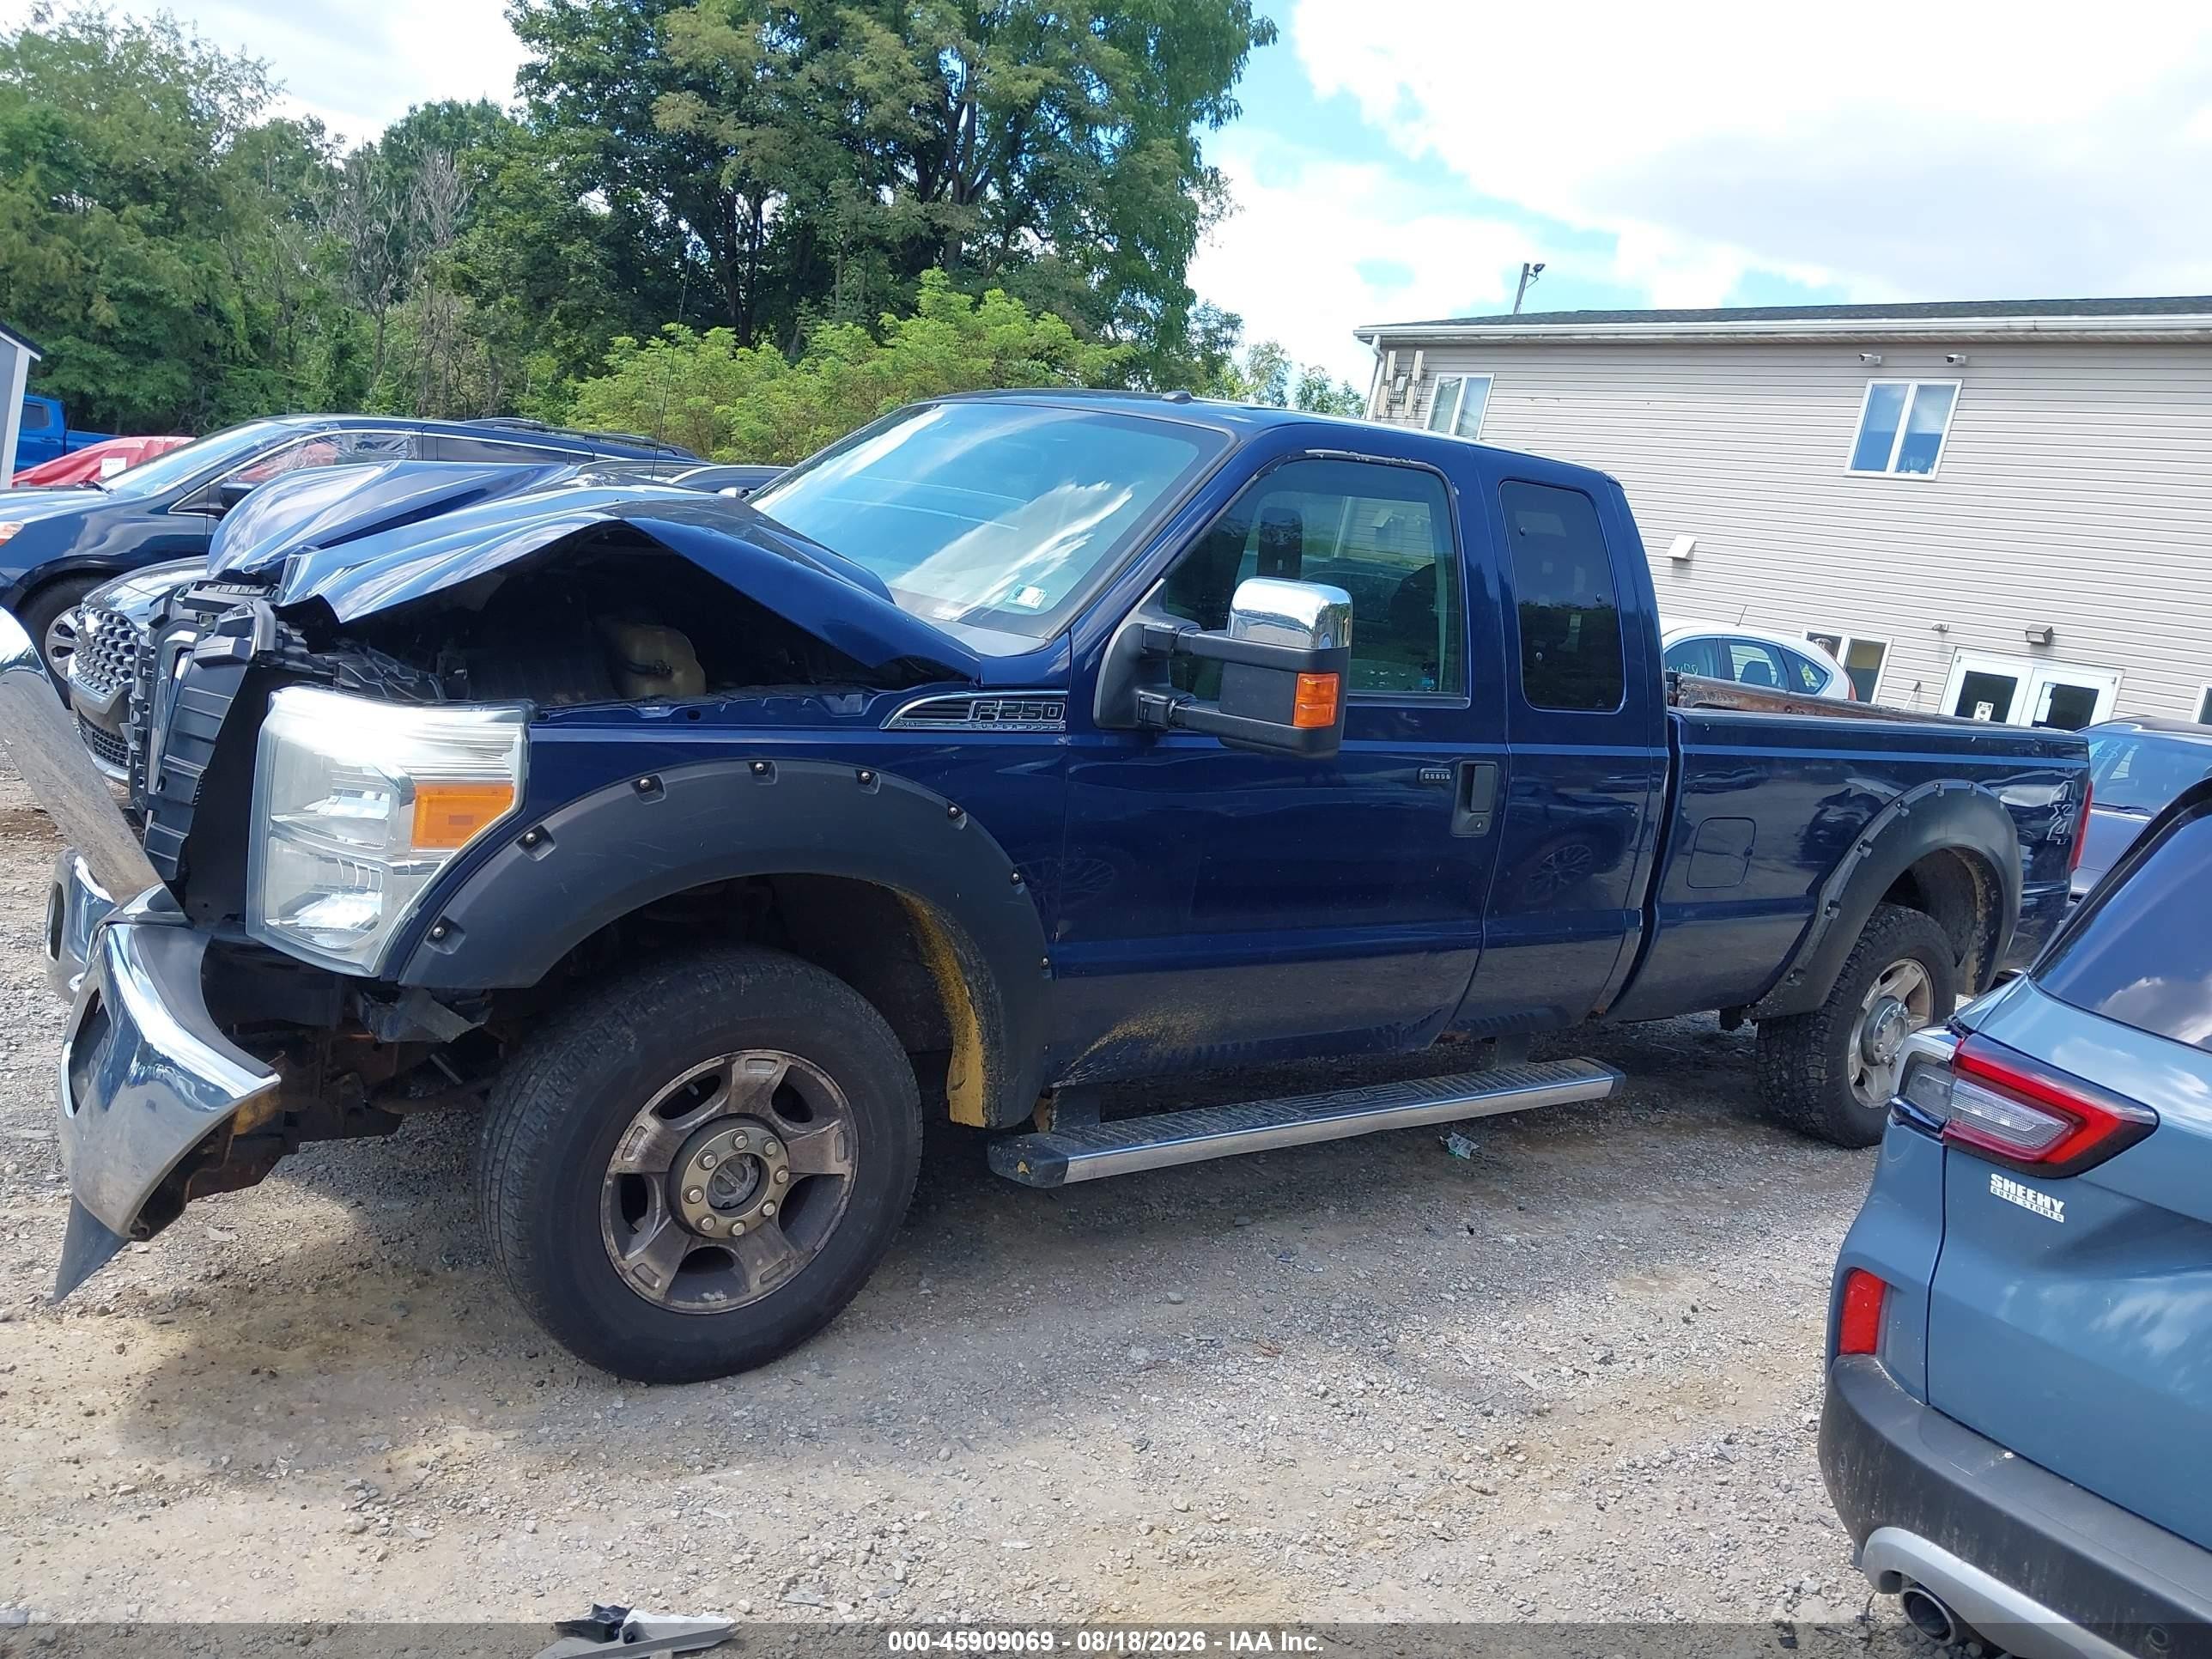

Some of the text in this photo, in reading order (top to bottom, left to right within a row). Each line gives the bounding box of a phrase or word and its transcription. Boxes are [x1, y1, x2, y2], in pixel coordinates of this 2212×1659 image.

[1990, 1173, 2065, 1213] SHEEHY
[1992, 1187, 2063, 1221] AUTO STORES
